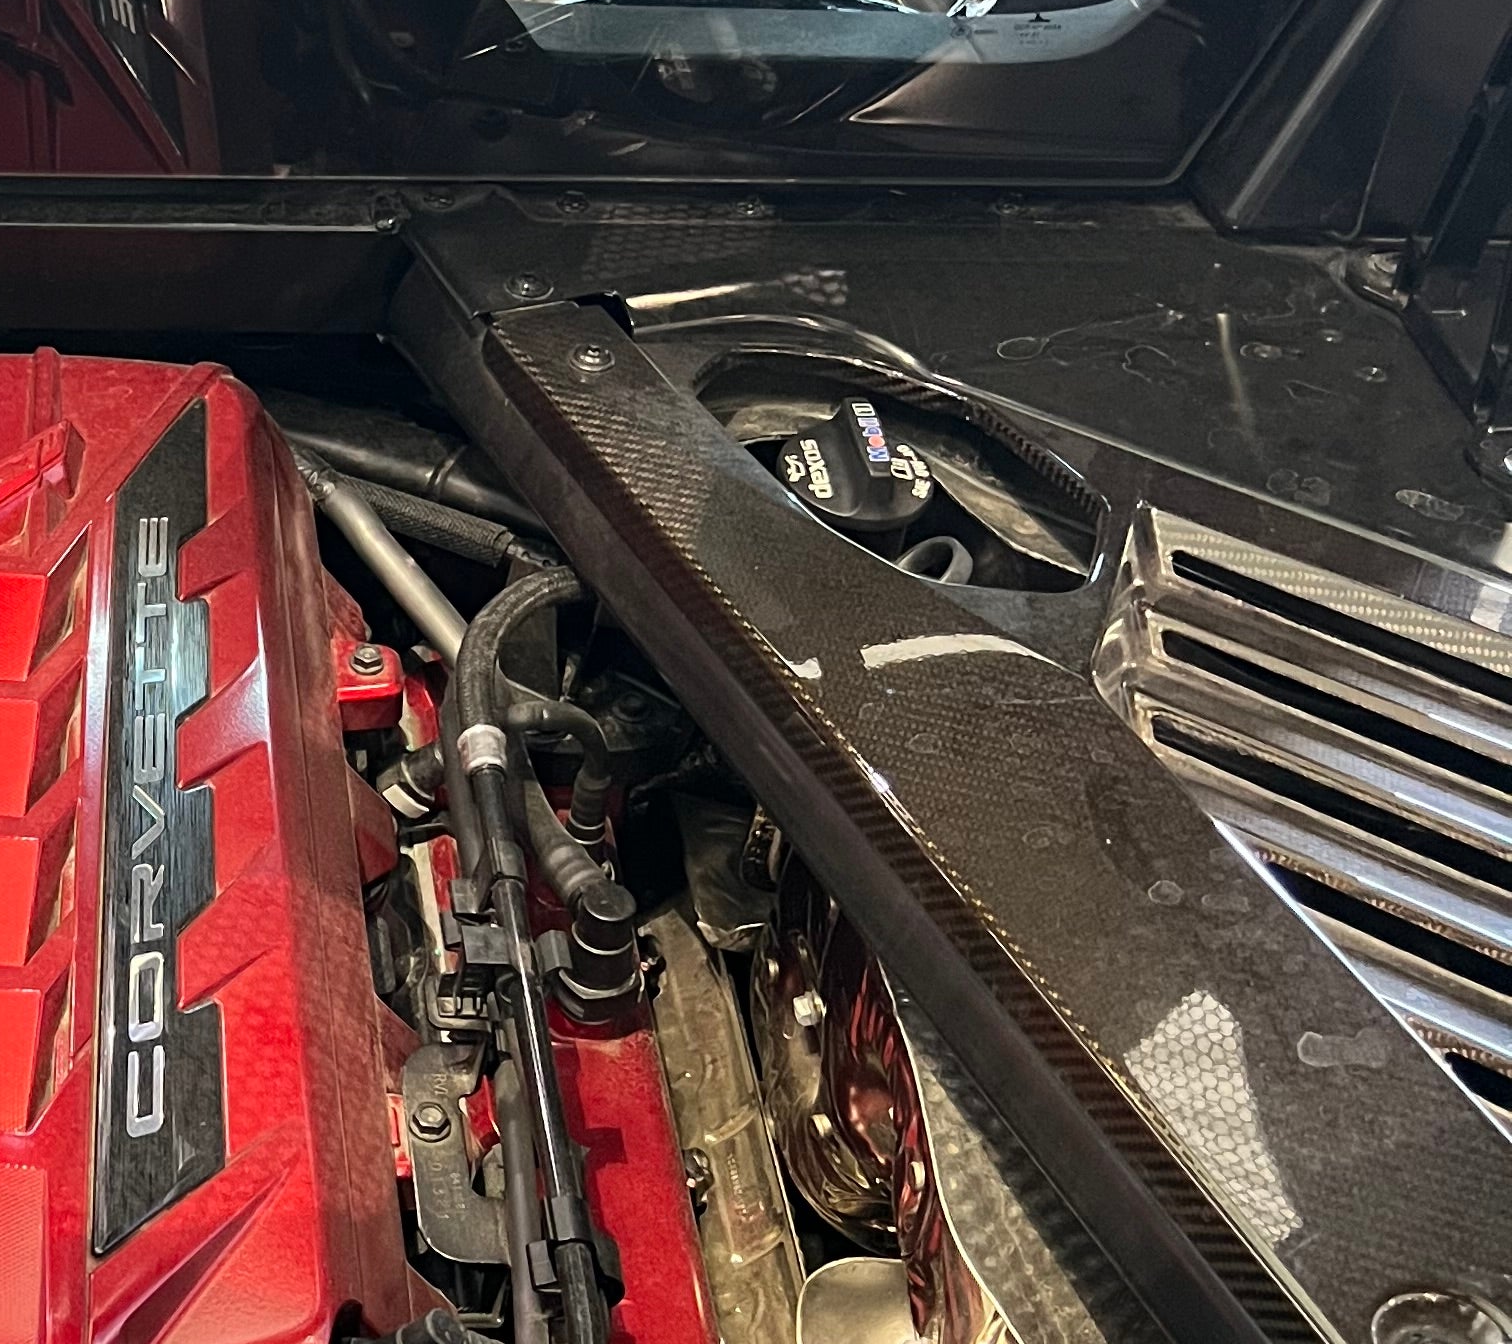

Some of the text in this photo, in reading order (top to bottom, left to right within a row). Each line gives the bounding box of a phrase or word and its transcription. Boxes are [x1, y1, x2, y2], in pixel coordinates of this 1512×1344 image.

[799, 438, 833, 499] dexos
[857, 417, 890, 462] Mobil
[126, 516, 169, 1139] CORVETTE
